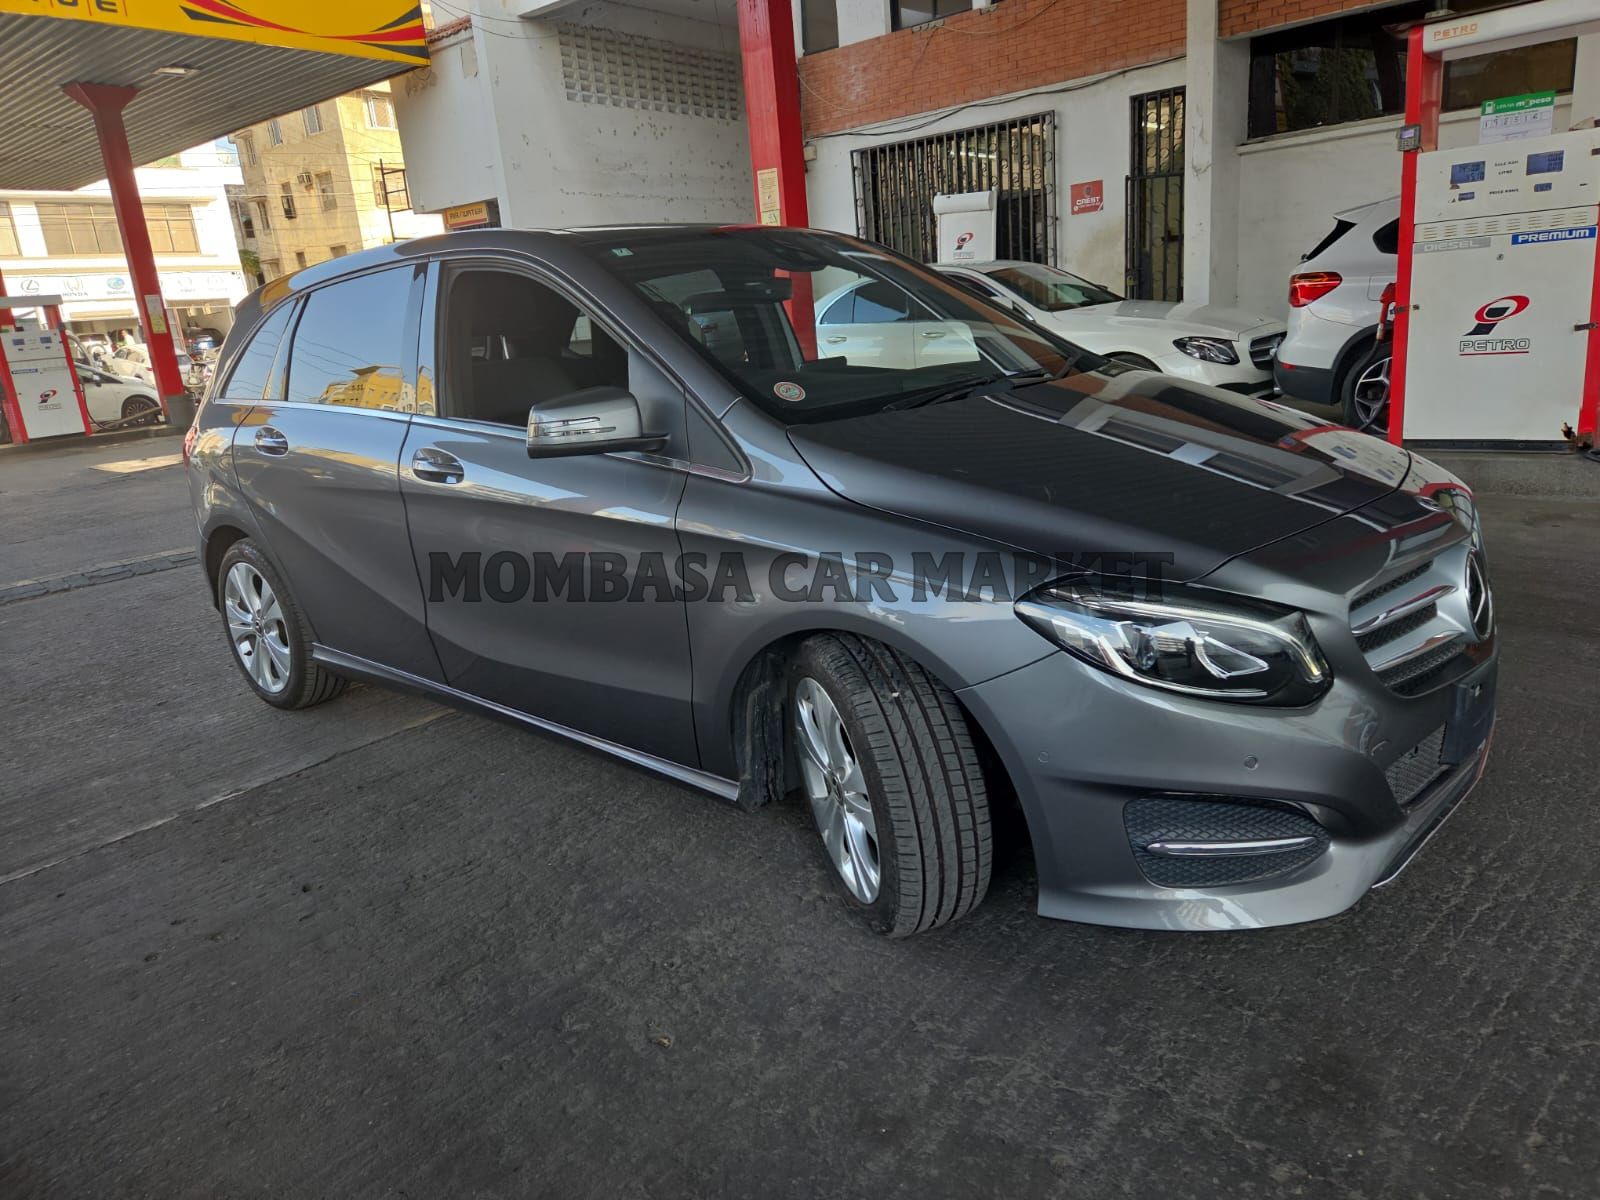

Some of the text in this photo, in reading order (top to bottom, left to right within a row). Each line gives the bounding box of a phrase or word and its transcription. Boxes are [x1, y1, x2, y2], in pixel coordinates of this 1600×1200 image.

[1433, 23, 1478, 40] PETRO
[1518, 229, 1589, 243] PREMIUM
[1424, 240, 1480, 252] DIESEL
[1460, 338, 1530, 352] PETRO
